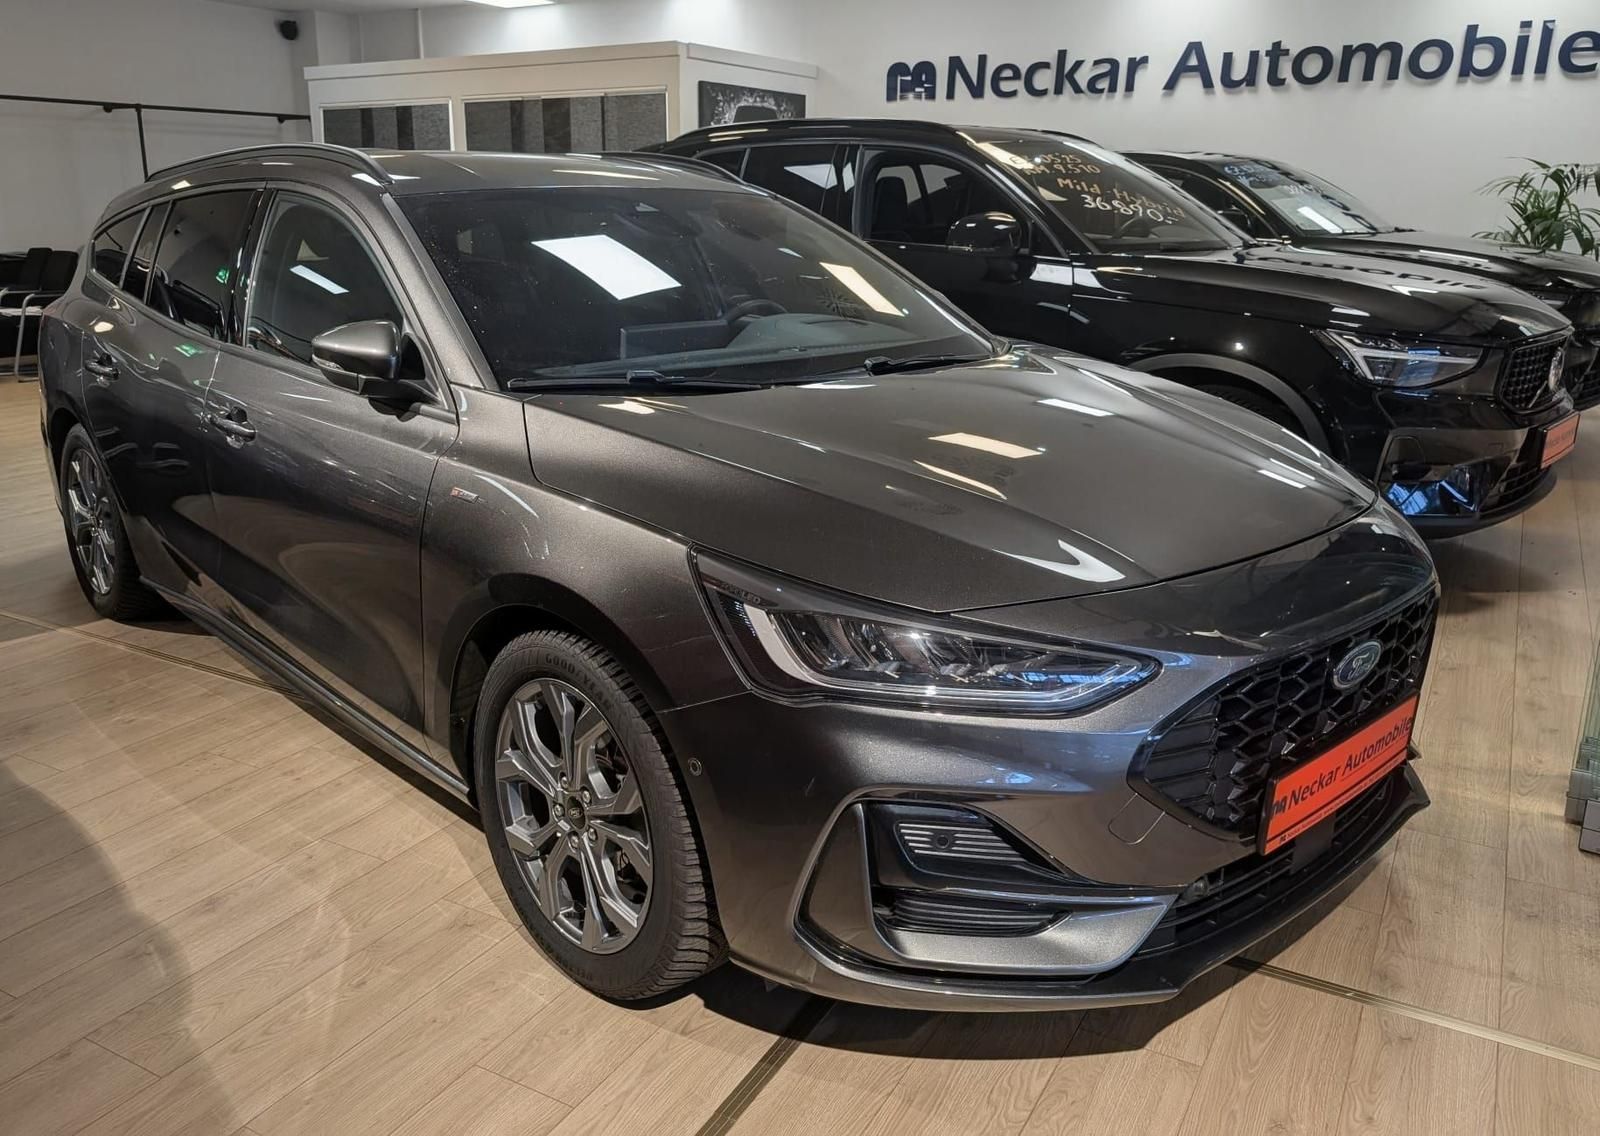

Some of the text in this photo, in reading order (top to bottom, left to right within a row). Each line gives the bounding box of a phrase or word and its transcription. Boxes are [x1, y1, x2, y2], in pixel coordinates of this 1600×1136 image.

[945, 49, 1149, 100] Neckar
[1162, 19, 1600, 91] Automobile
[1347, 651, 1375, 682] Ford
[1287, 767, 1342, 806] Neckar
[1341, 718, 1412, 773] Automobile
